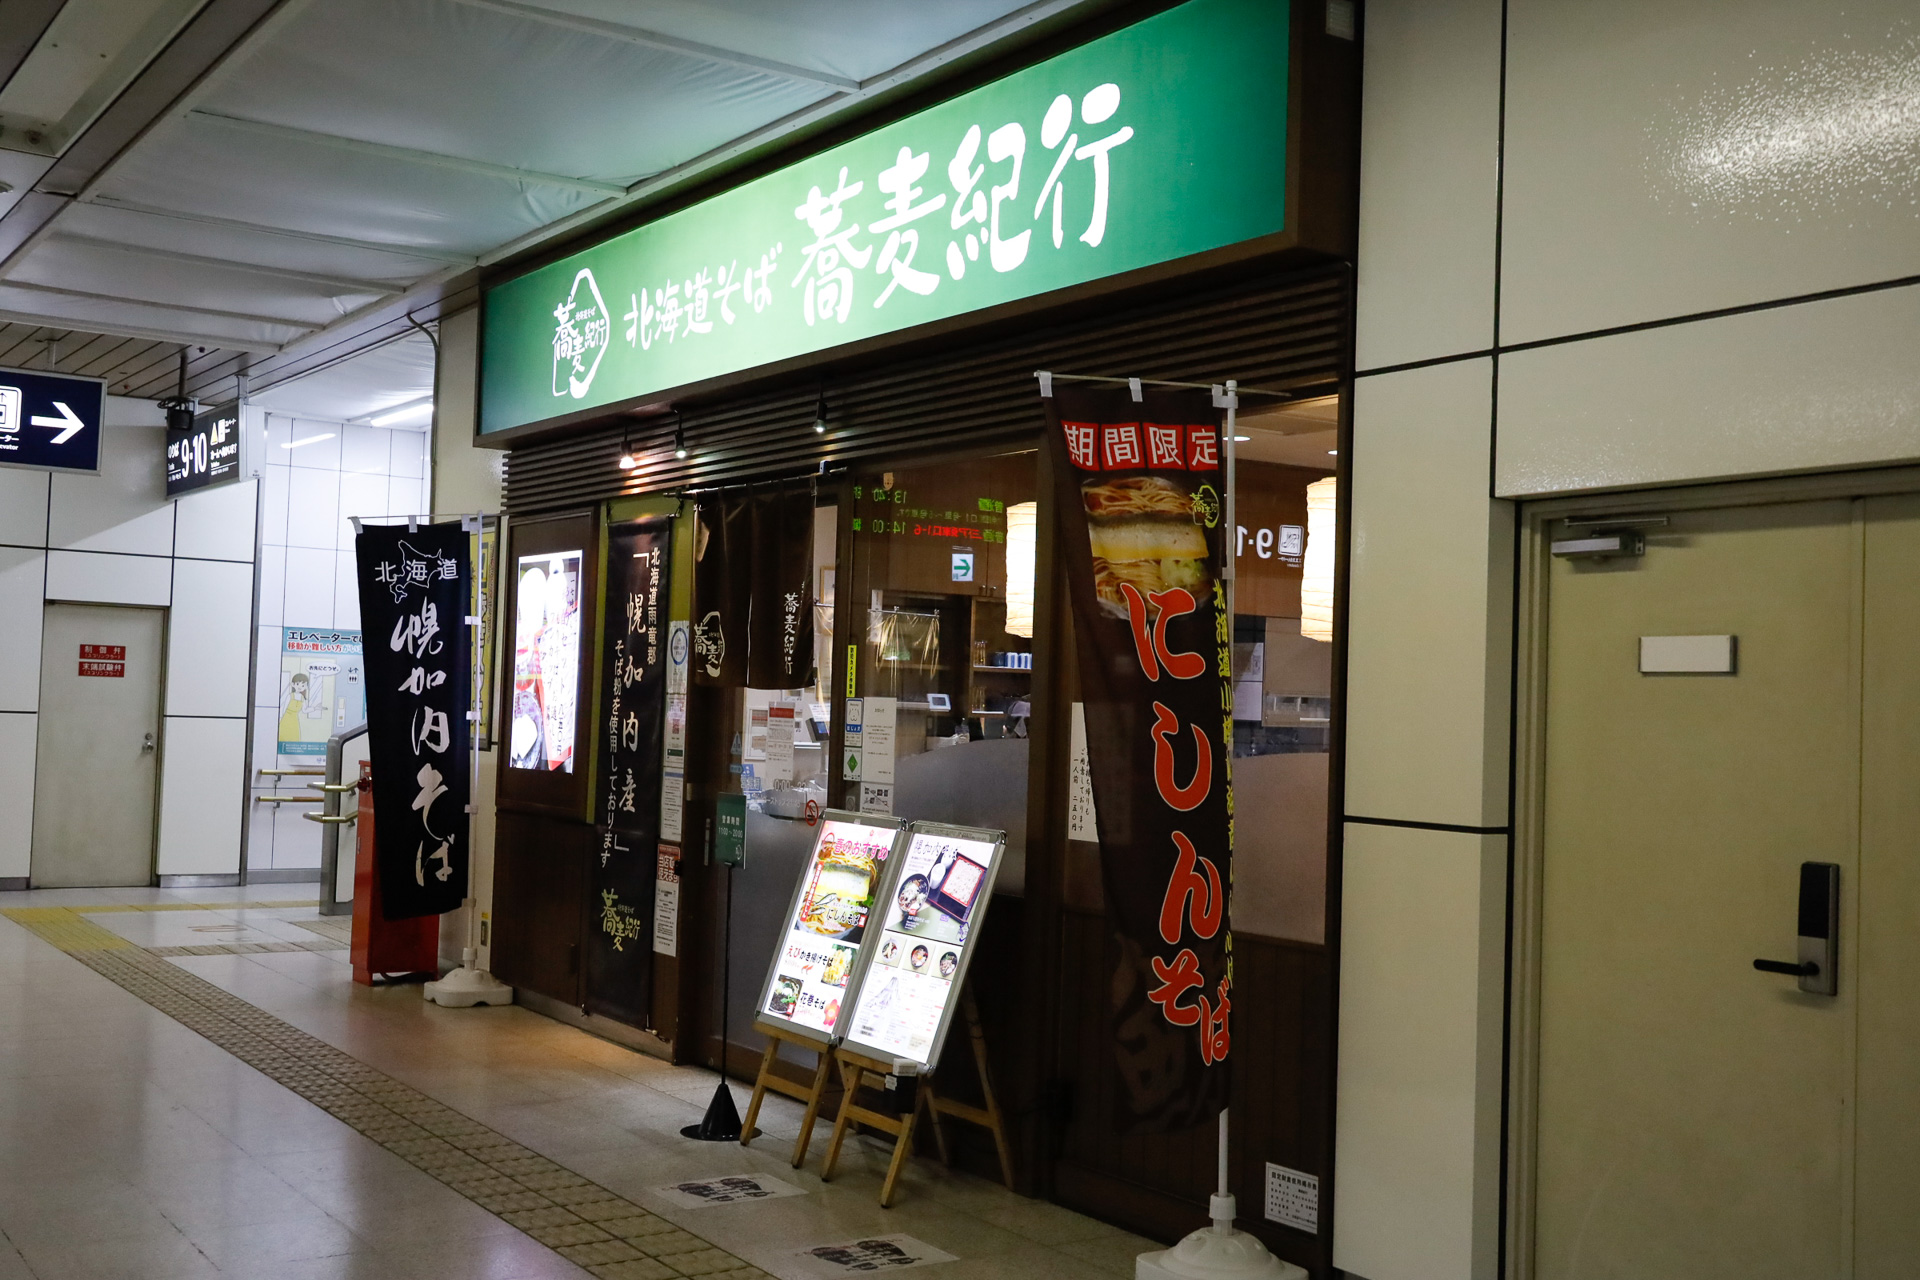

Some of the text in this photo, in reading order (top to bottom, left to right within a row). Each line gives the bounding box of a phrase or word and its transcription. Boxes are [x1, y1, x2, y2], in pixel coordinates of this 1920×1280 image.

[623, 82, 1135, 350] 北海道そば 蕎麦紀行
[1063, 424, 1219, 467] 期間限定
[374, 558, 460, 583] 北海道
[390, 596, 456, 887] 幌加内そば
[600, 639, 625, 868] そば粉を使用しております
[834, 838, 889, 861] 春のおすすめ
[1119, 582, 1232, 1067] にしんそば
